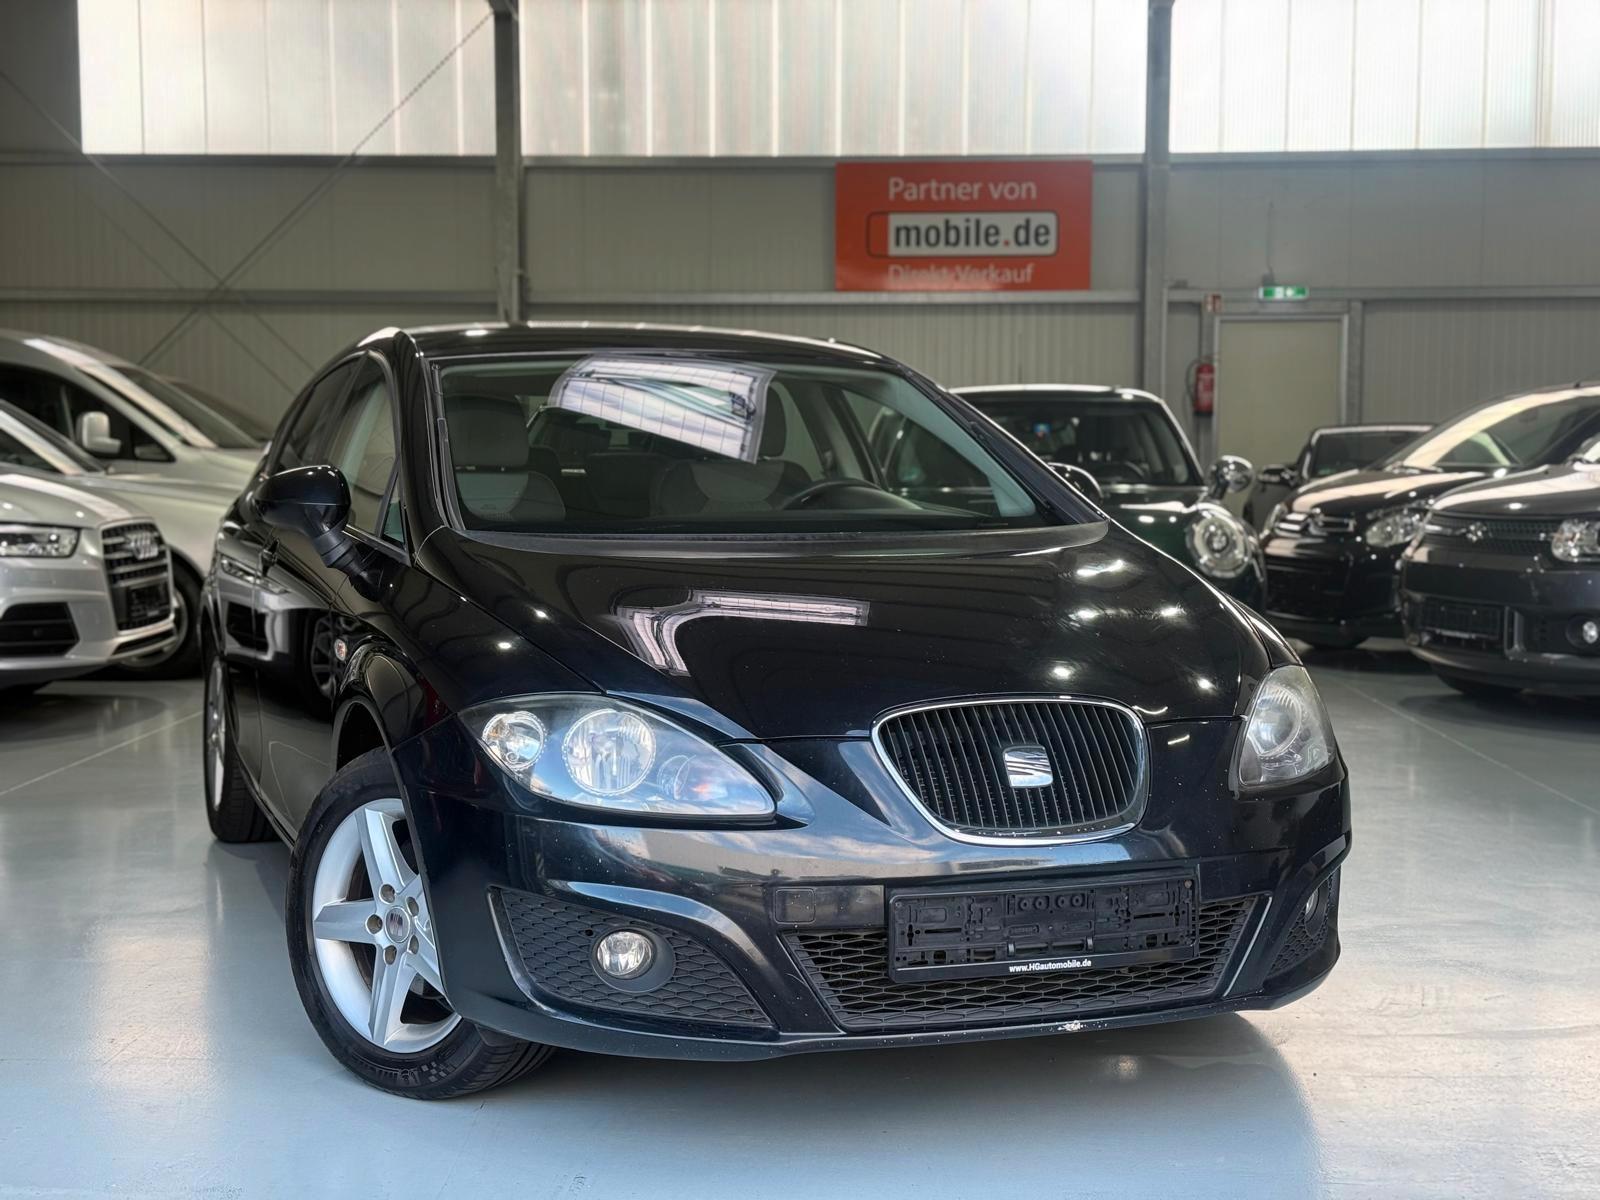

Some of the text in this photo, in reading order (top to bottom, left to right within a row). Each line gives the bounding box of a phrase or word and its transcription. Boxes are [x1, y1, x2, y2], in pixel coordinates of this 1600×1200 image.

[888, 177, 1037, 201] Partner von
[894, 218, 1051, 247] mobile.de
[1008, 958, 1092, 973] www.HGautomobile.de
